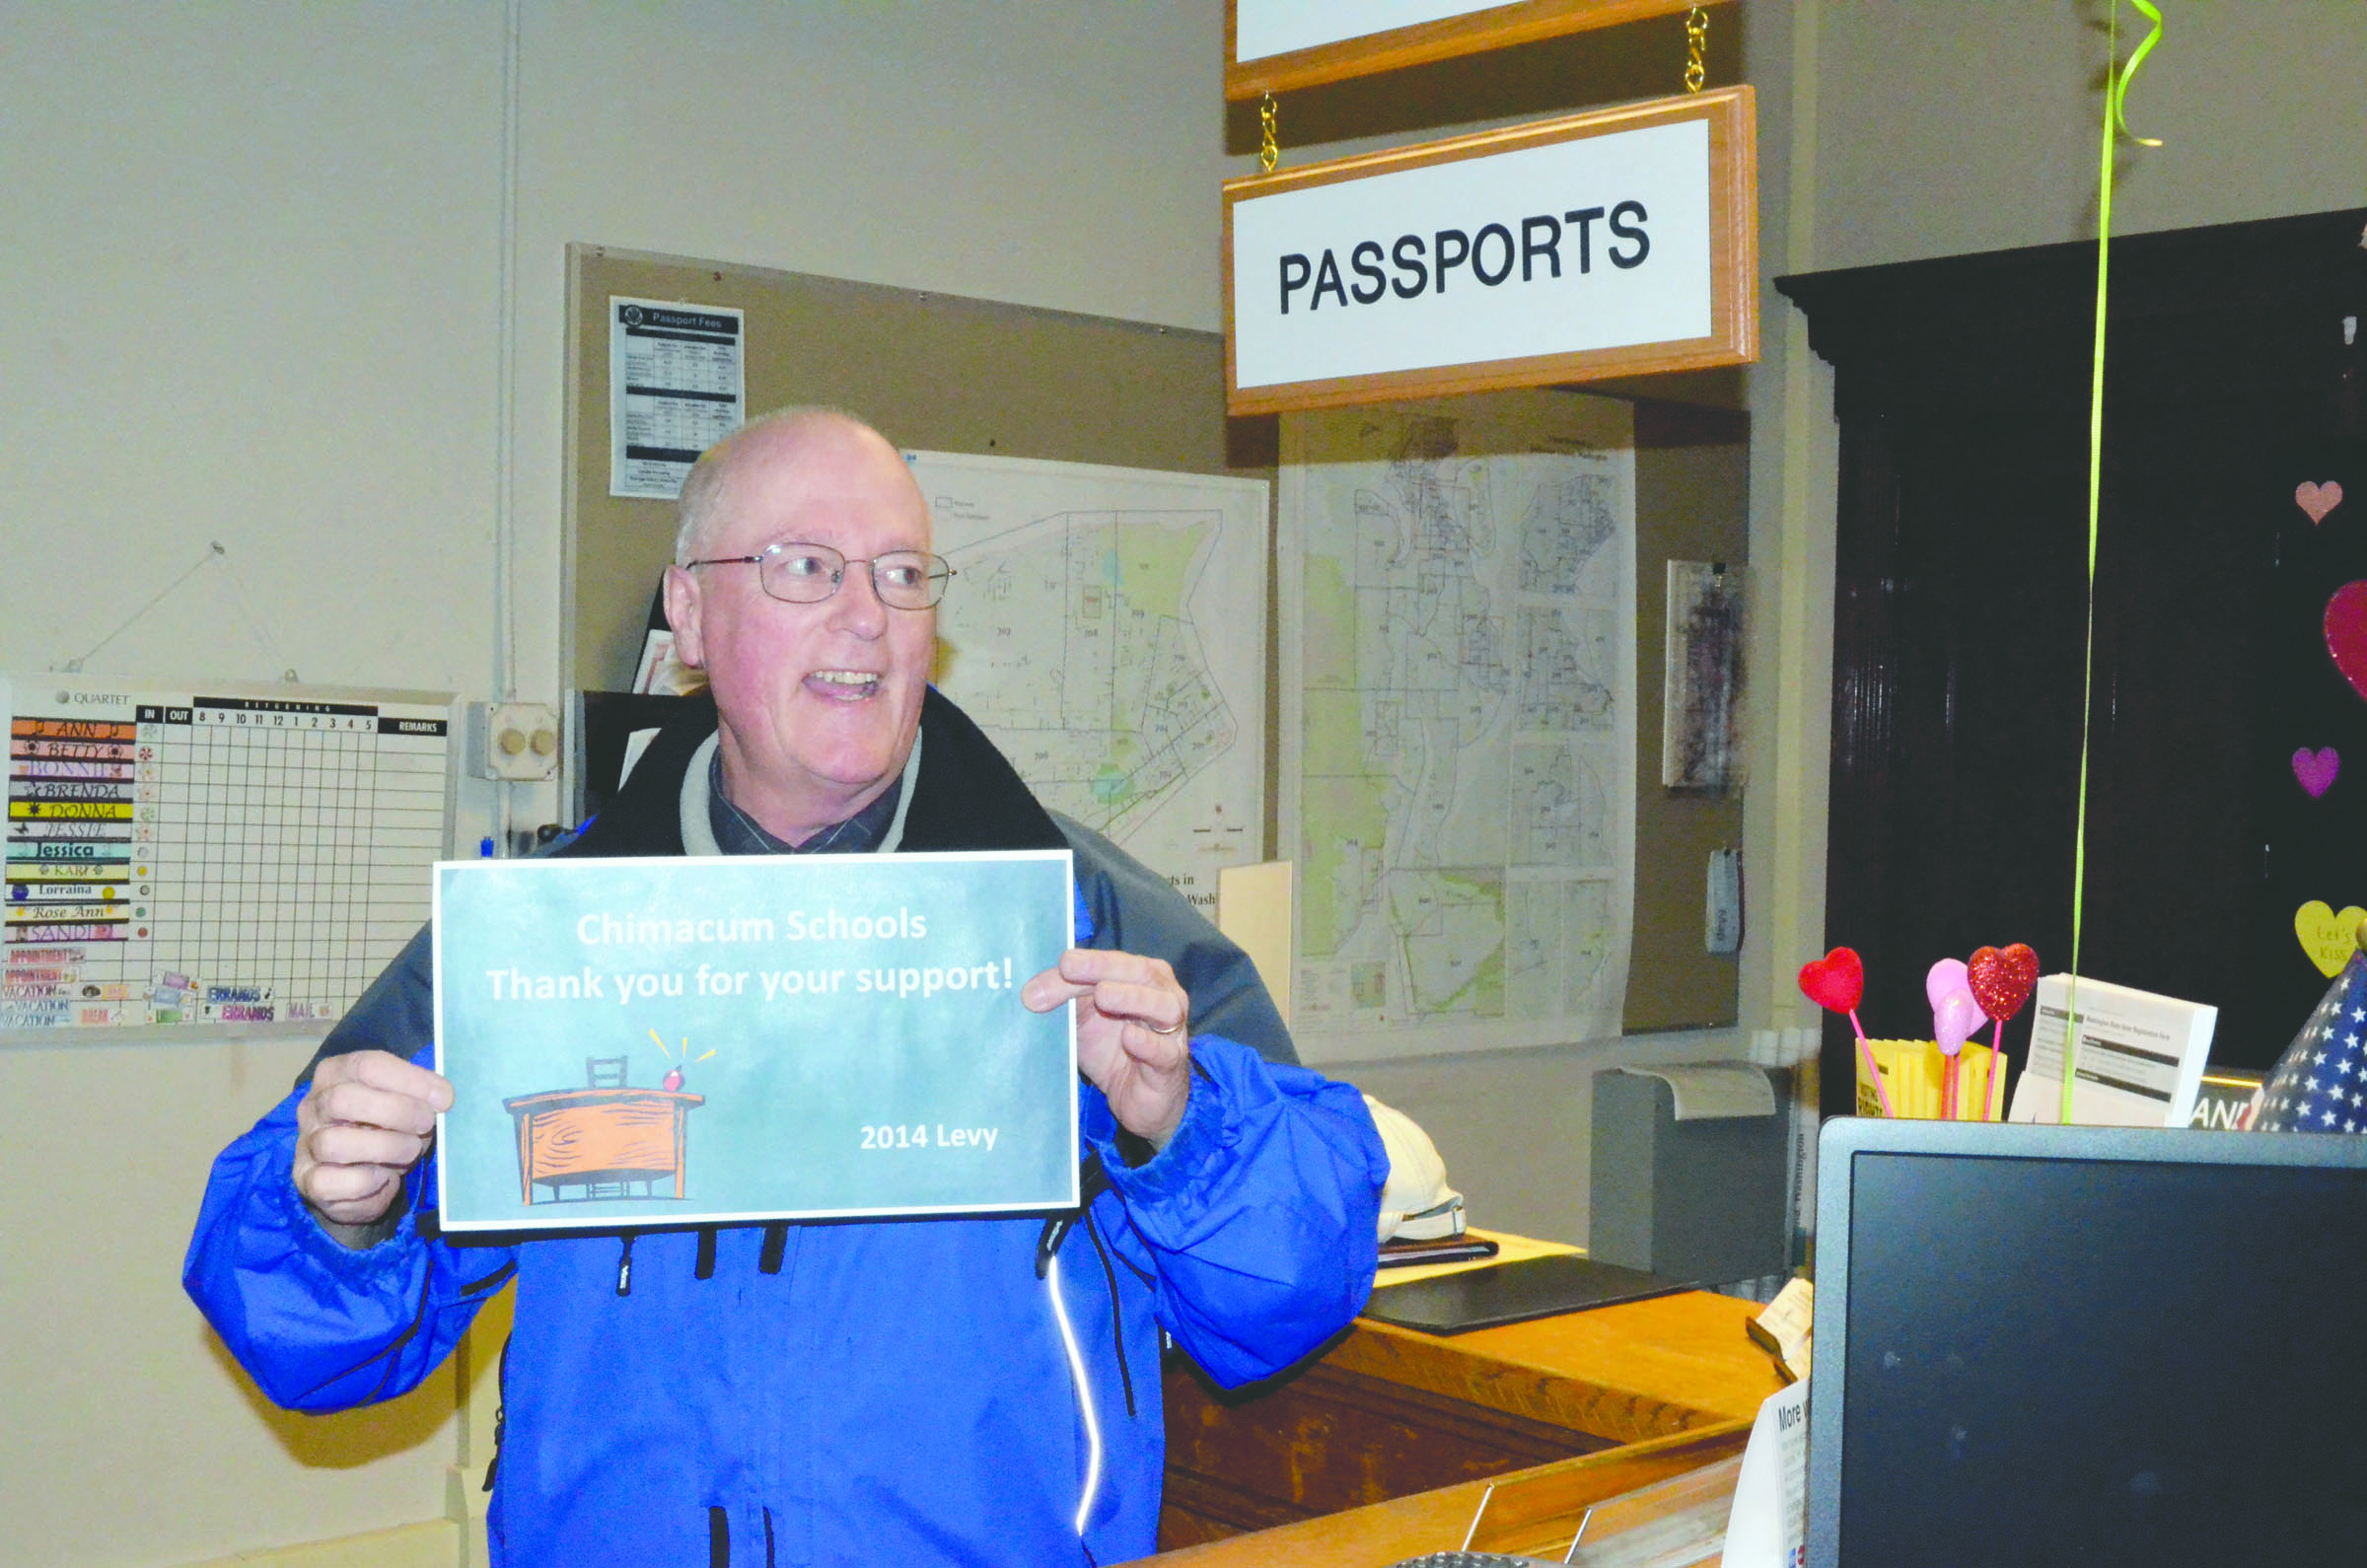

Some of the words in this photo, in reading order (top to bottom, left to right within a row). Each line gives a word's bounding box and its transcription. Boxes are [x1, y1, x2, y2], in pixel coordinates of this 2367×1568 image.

[1279, 199, 1651, 316] PASSPORTS
[652, 312, 696, 326] Passport
[698, 317, 723, 328] Fees
[74, 692, 129, 705] QUARTET
[244, 701, 330, 713] RETURNING
[144, 709, 156, 720] IN
[169, 710, 189, 721] OUT
[198, 711, 206, 722] 8
[218, 713, 226, 724] 9
[236, 713, 247, 724] 10
[255, 715, 263, 725] 11
[273, 715, 284, 726] 12
[311, 717, 319, 728] 2
[328, 718, 336, 728] 3
[347, 719, 354, 729] 4
[365, 720, 372, 730] 5
[56, 721, 97, 738] ANN
[398, 721, 438, 733] REMARKS
[48, 742, 103, 757] BETTY
[45, 783, 120, 799] BRENDA
[48, 802, 117, 819] DONNA
[36, 841, 95, 858] Jessica
[1184, 873, 1194, 886] in
[33, 906, 67, 919] Rose
[71, 905, 104, 918] Ann
[576, 910, 775, 947] Chimacum
[786, 906, 928, 942] Schools
[485, 967, 604, 1002] Thank
[615, 971, 684, 1004] you
[696, 962, 750, 996] for
[759, 968, 846, 1000] your
[855, 957, 1014, 998] support!
[2, 985, 57, 998] VACATION
[207, 986, 261, 1003] ERRANDS
[222, 1003, 275, 1022] ERRANDS
[287, 1001, 316, 1020] MAIL
[860, 1123, 928, 1151] 2014
[936, 1123, 998, 1153] Levy
[1778, 1401, 1802, 1433] More
